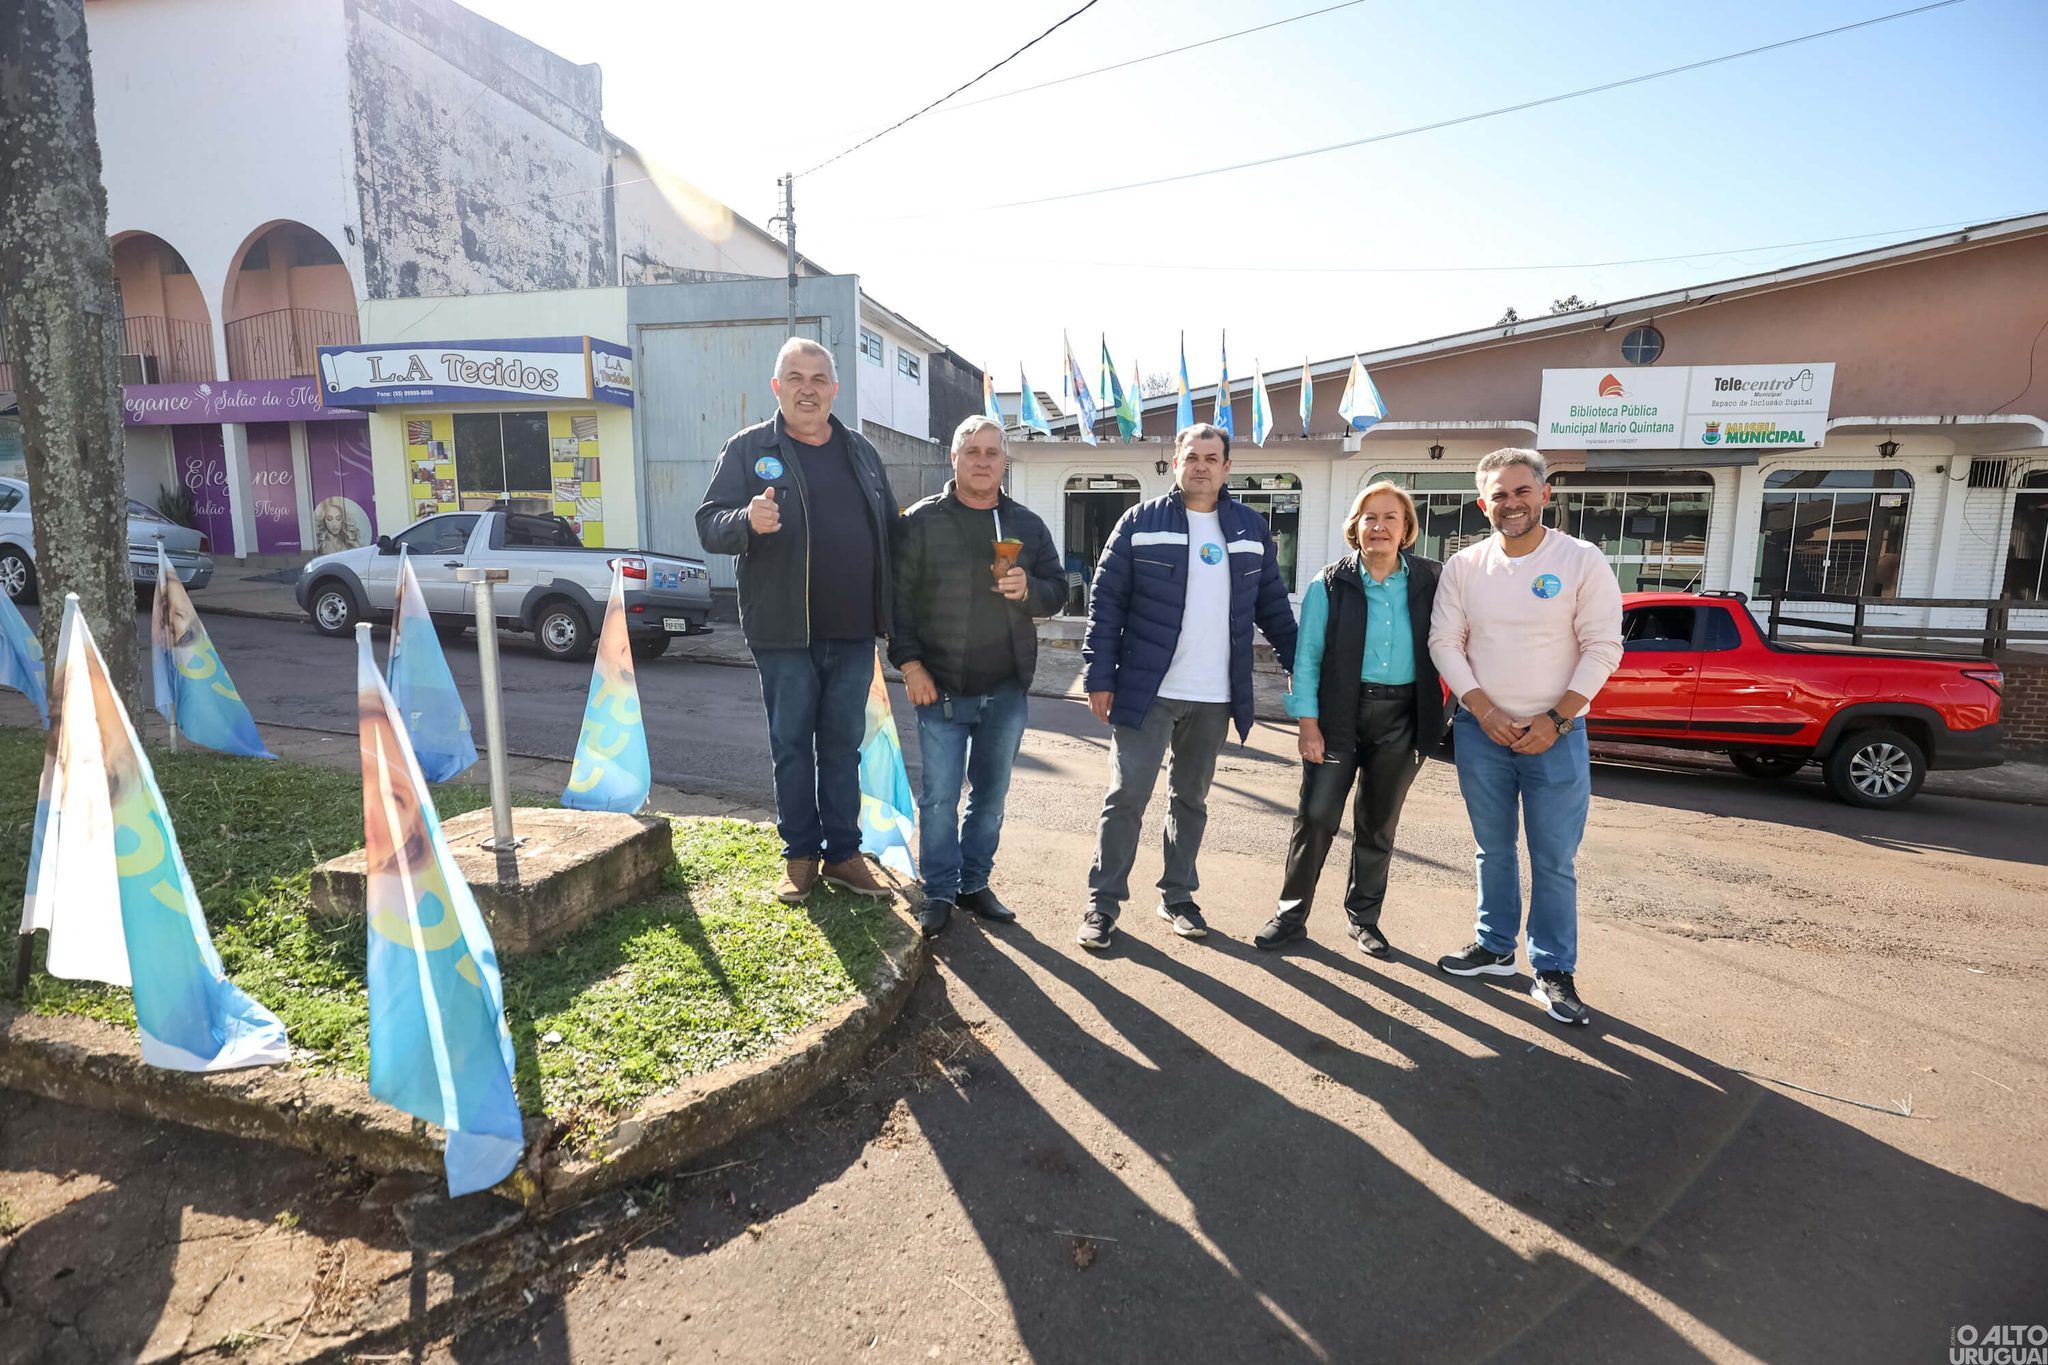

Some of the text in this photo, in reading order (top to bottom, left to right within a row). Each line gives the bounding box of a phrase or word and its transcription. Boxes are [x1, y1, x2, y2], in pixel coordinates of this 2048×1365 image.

[367, 354, 559, 391] L.A Tecidos
[1714, 377, 1794, 391] Telecentro
[122, 386, 321, 422] legance Salão da Neg
[1712, 399, 1738, 407] Espaço
[1785, 398, 1813, 406] Digital
[1570, 404, 1657, 417] Biblioteca Pública
[1550, 421, 1674, 436] Municipal Mario Quintana
[1725, 422, 1776, 434] MUSEU
[1725, 431, 1806, 444] MUNICIPAL
[185, 456, 293, 496] Elence
